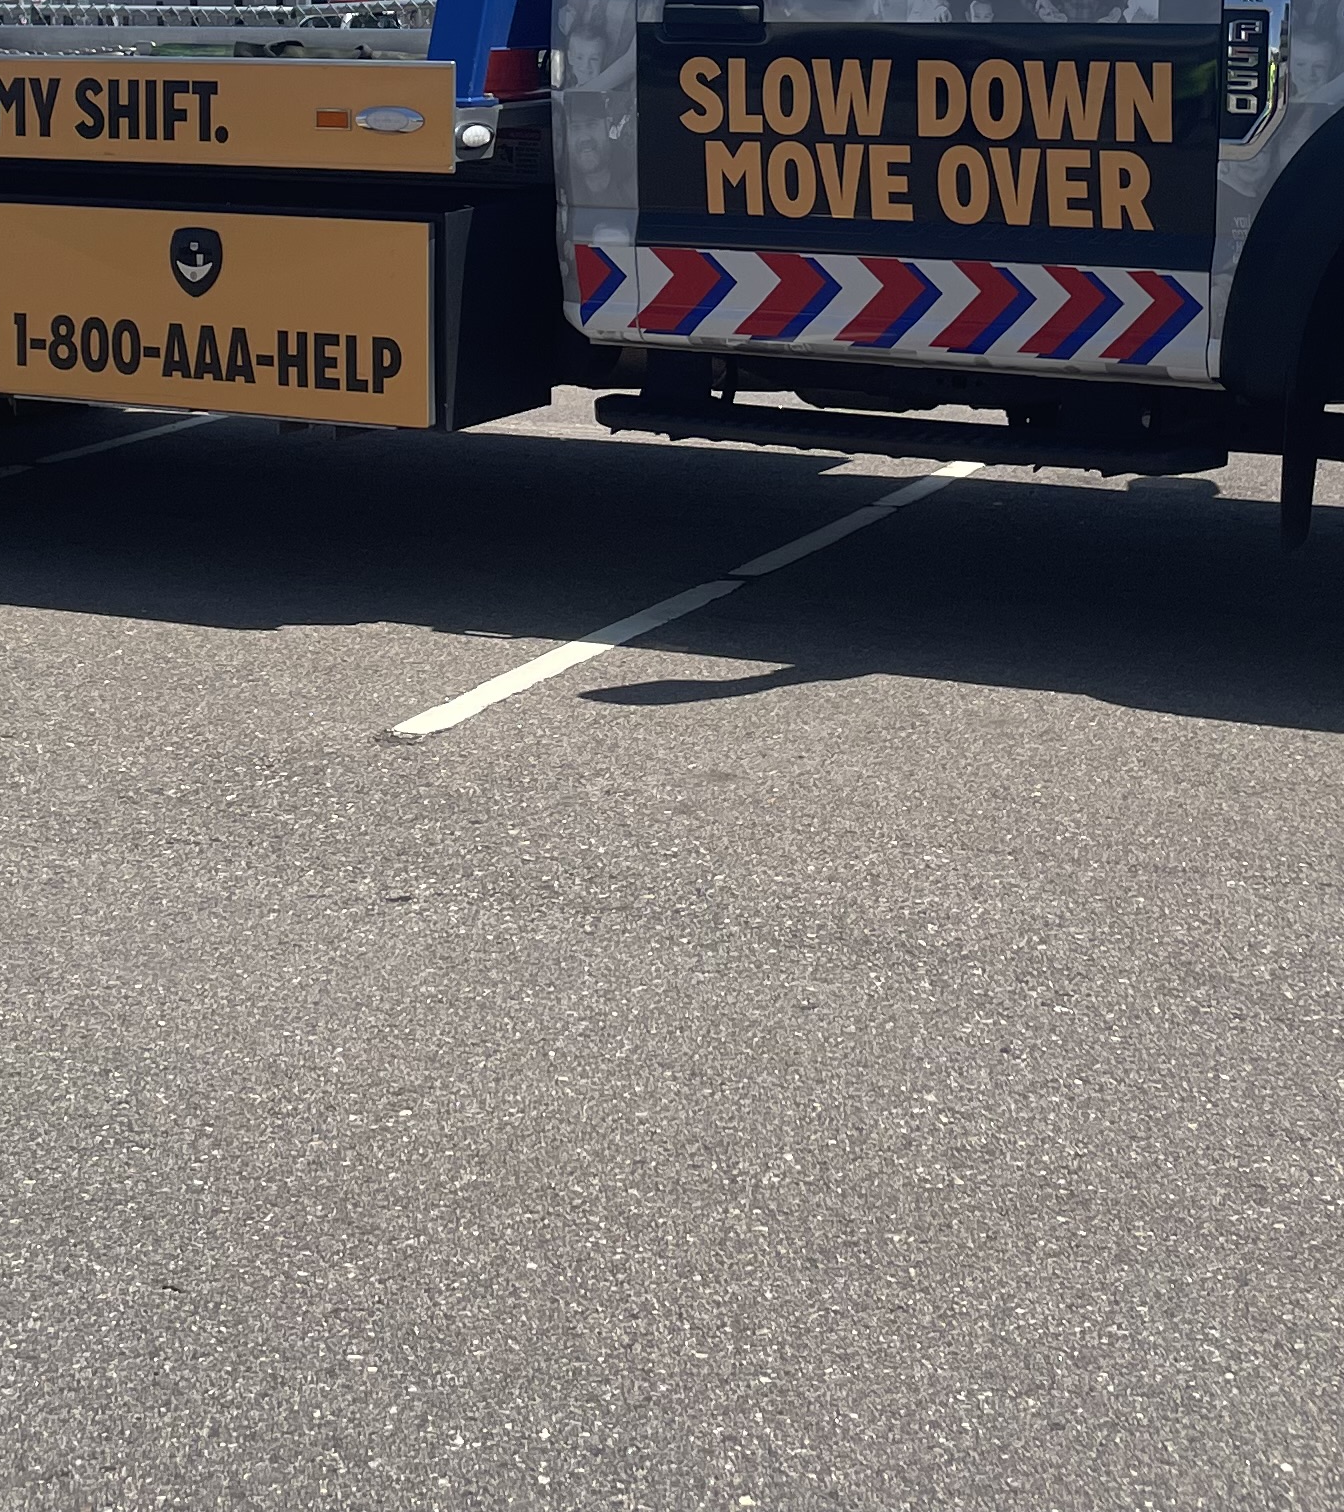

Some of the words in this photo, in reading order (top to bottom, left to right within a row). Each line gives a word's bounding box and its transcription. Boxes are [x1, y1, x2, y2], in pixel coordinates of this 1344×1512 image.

[74, 77, 229, 144] SHIFT.
[678, 56, 893, 137] SLOW
[917, 58, 1173, 144] DOWN
[704, 140, 915, 222] MOVE
[937, 144, 1155, 232] OVER
[13, 312, 403, 394] 1-800-AAA-HELP
